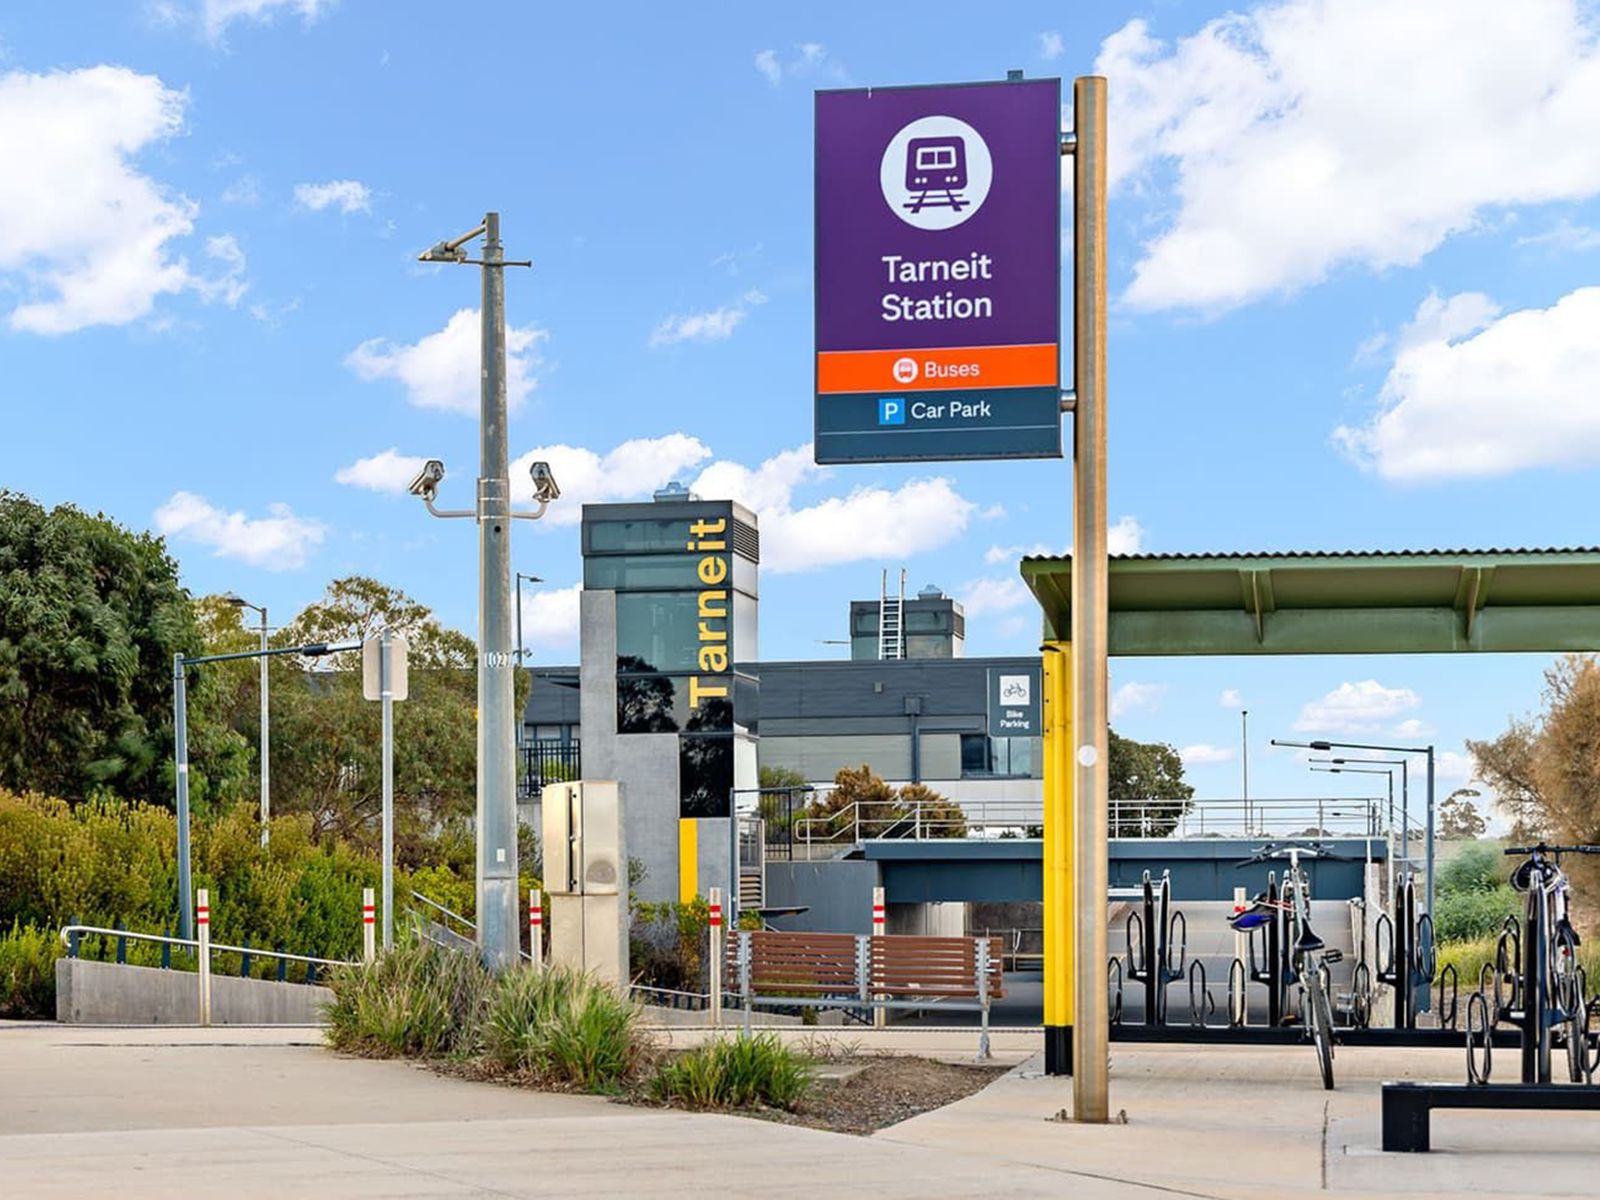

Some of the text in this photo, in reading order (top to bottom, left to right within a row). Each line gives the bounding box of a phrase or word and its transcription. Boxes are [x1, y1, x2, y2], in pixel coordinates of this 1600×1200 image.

[881, 251, 992, 283] Tarneit
[881, 291, 993, 322] Station
[924, 361, 980, 379] Buses
[885, 401, 992, 421] P Car Park
[687, 518, 728, 709] Tarneit
[1000, 719, 1030, 730] Parking
